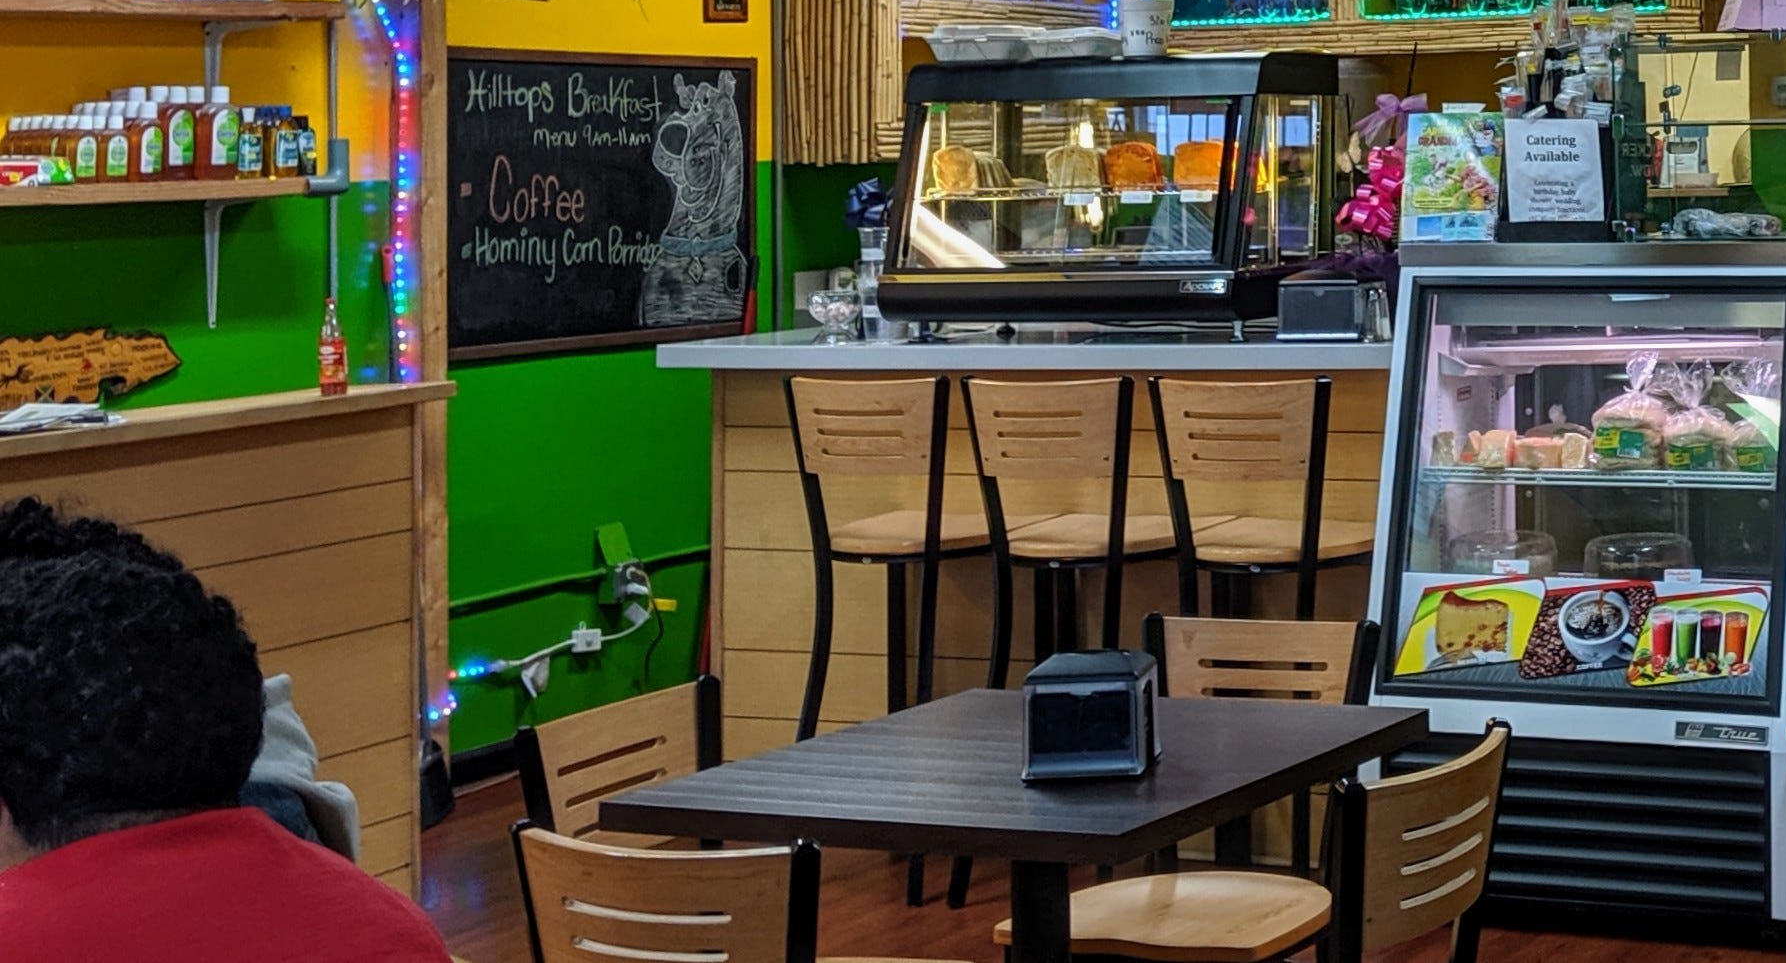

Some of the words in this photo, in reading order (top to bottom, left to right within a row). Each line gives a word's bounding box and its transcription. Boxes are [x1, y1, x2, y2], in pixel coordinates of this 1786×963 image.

[464, 69, 555, 123] Hilltops
[567, 71, 663, 122] Breakfast
[1523, 150, 1581, 162] Available
[1525, 134, 1577, 148] Catering
[488, 154, 586, 224] Coffee
[474, 226, 557, 284] Hominy
[562, 227, 604, 267] Corn
